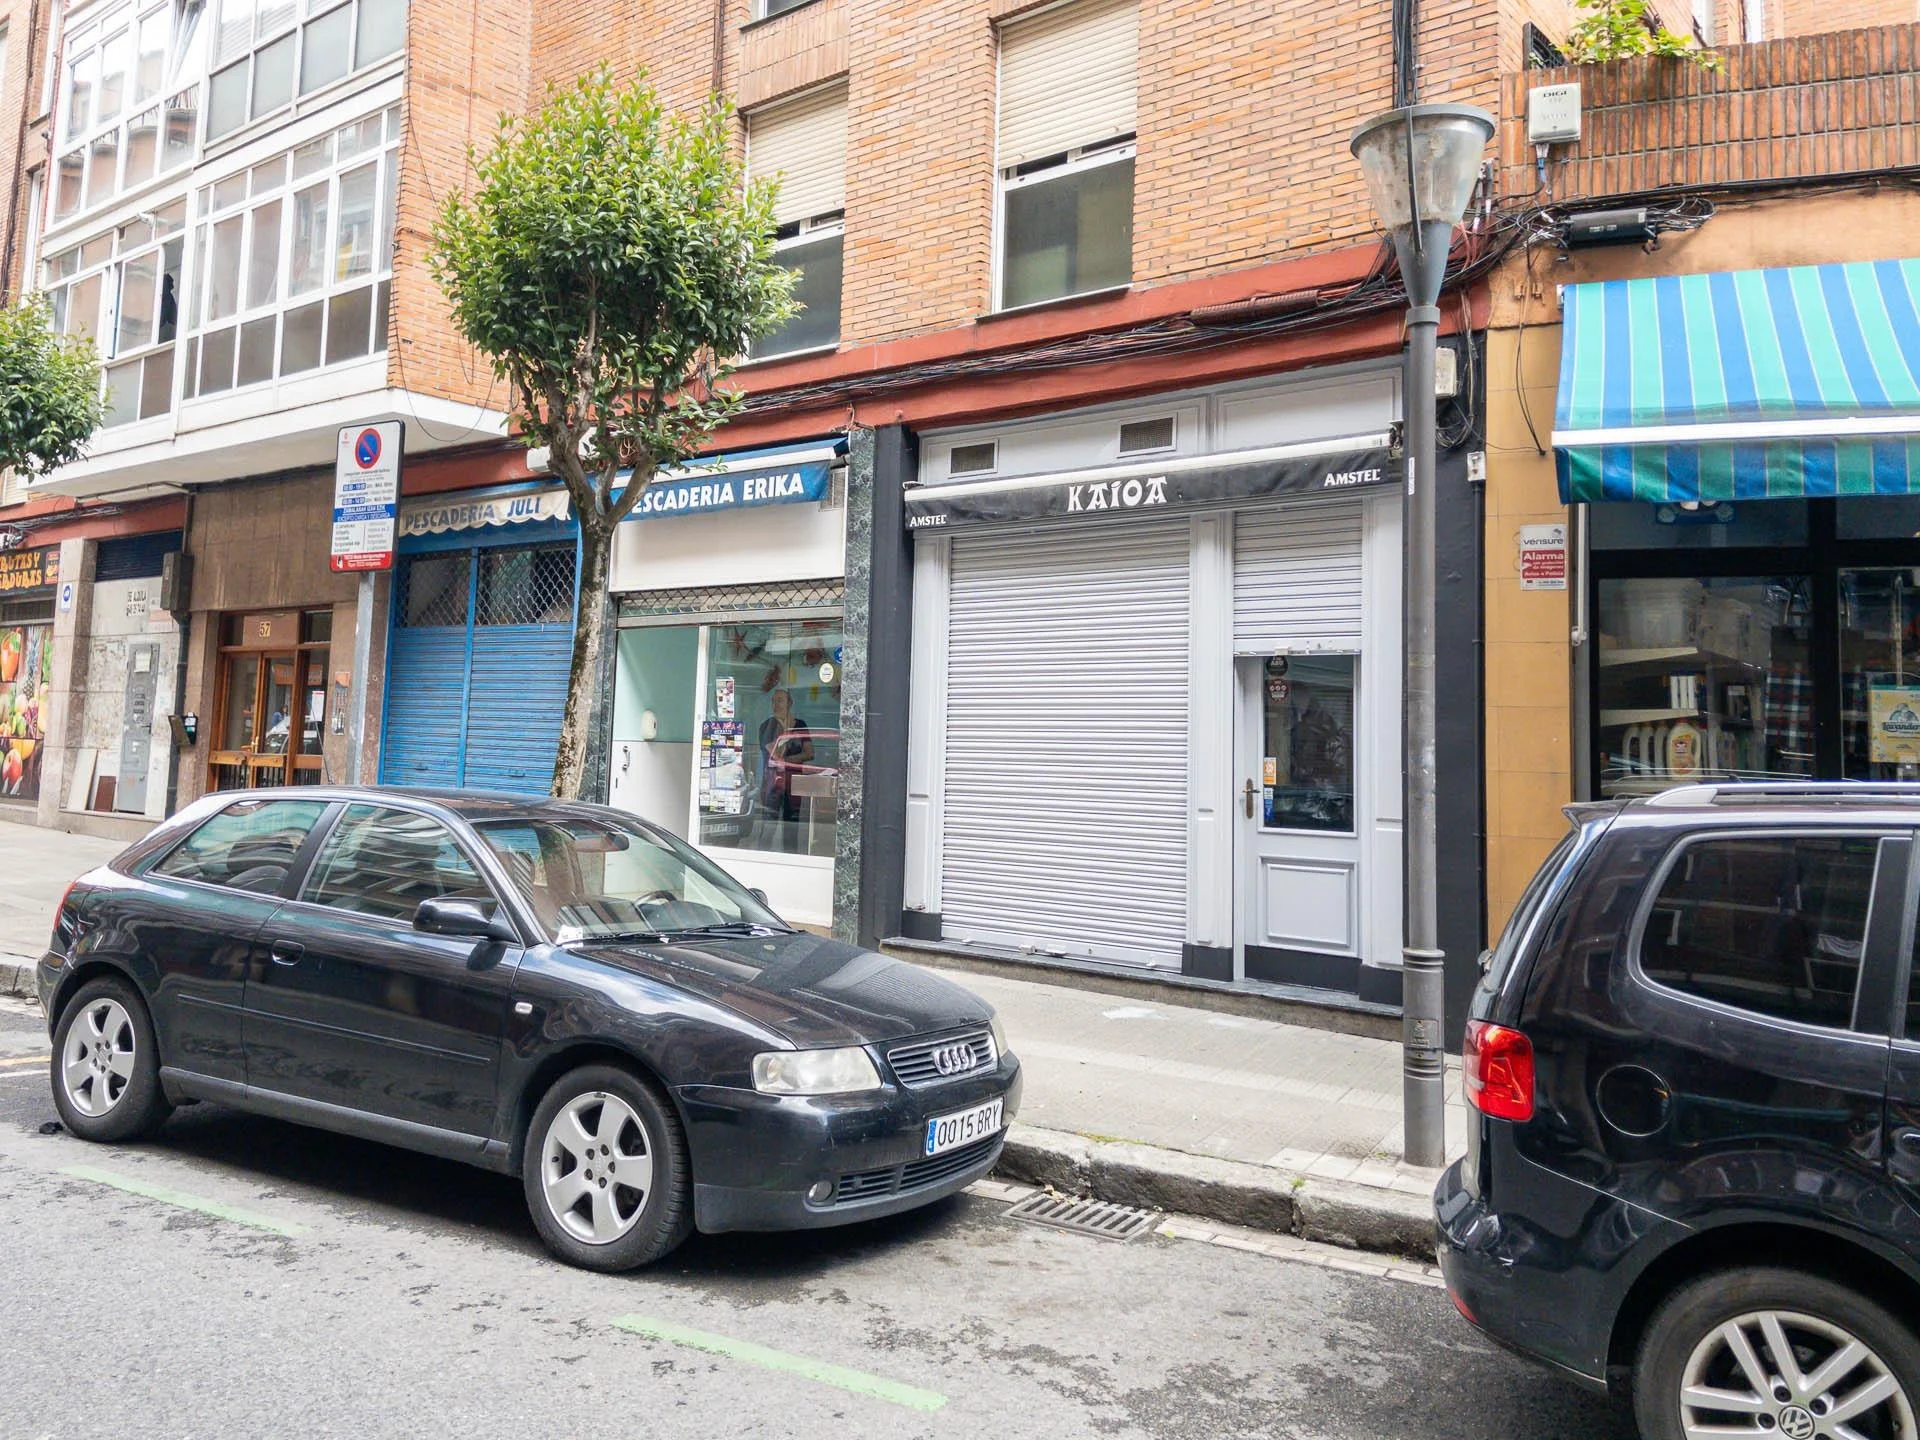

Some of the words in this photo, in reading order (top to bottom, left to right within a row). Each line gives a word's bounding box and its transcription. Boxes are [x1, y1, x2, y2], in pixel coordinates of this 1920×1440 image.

[1544, 90, 1567, 98] DIGI
[1324, 468, 1381, 487] AMSTEL
[631, 482, 735, 514] ESCADERIA
[743, 472, 804, 501] ERIKA
[405, 503, 496, 530] PESCADERIA
[507, 496, 541, 518] JULI
[909, 514, 948, 528] AMSTEL
[1523, 551, 1564, 560] Alarma
[260, 622, 271, 636] 57
[937, 1114, 974, 1147] 0015
[977, 1103, 1000, 1135] BRY
